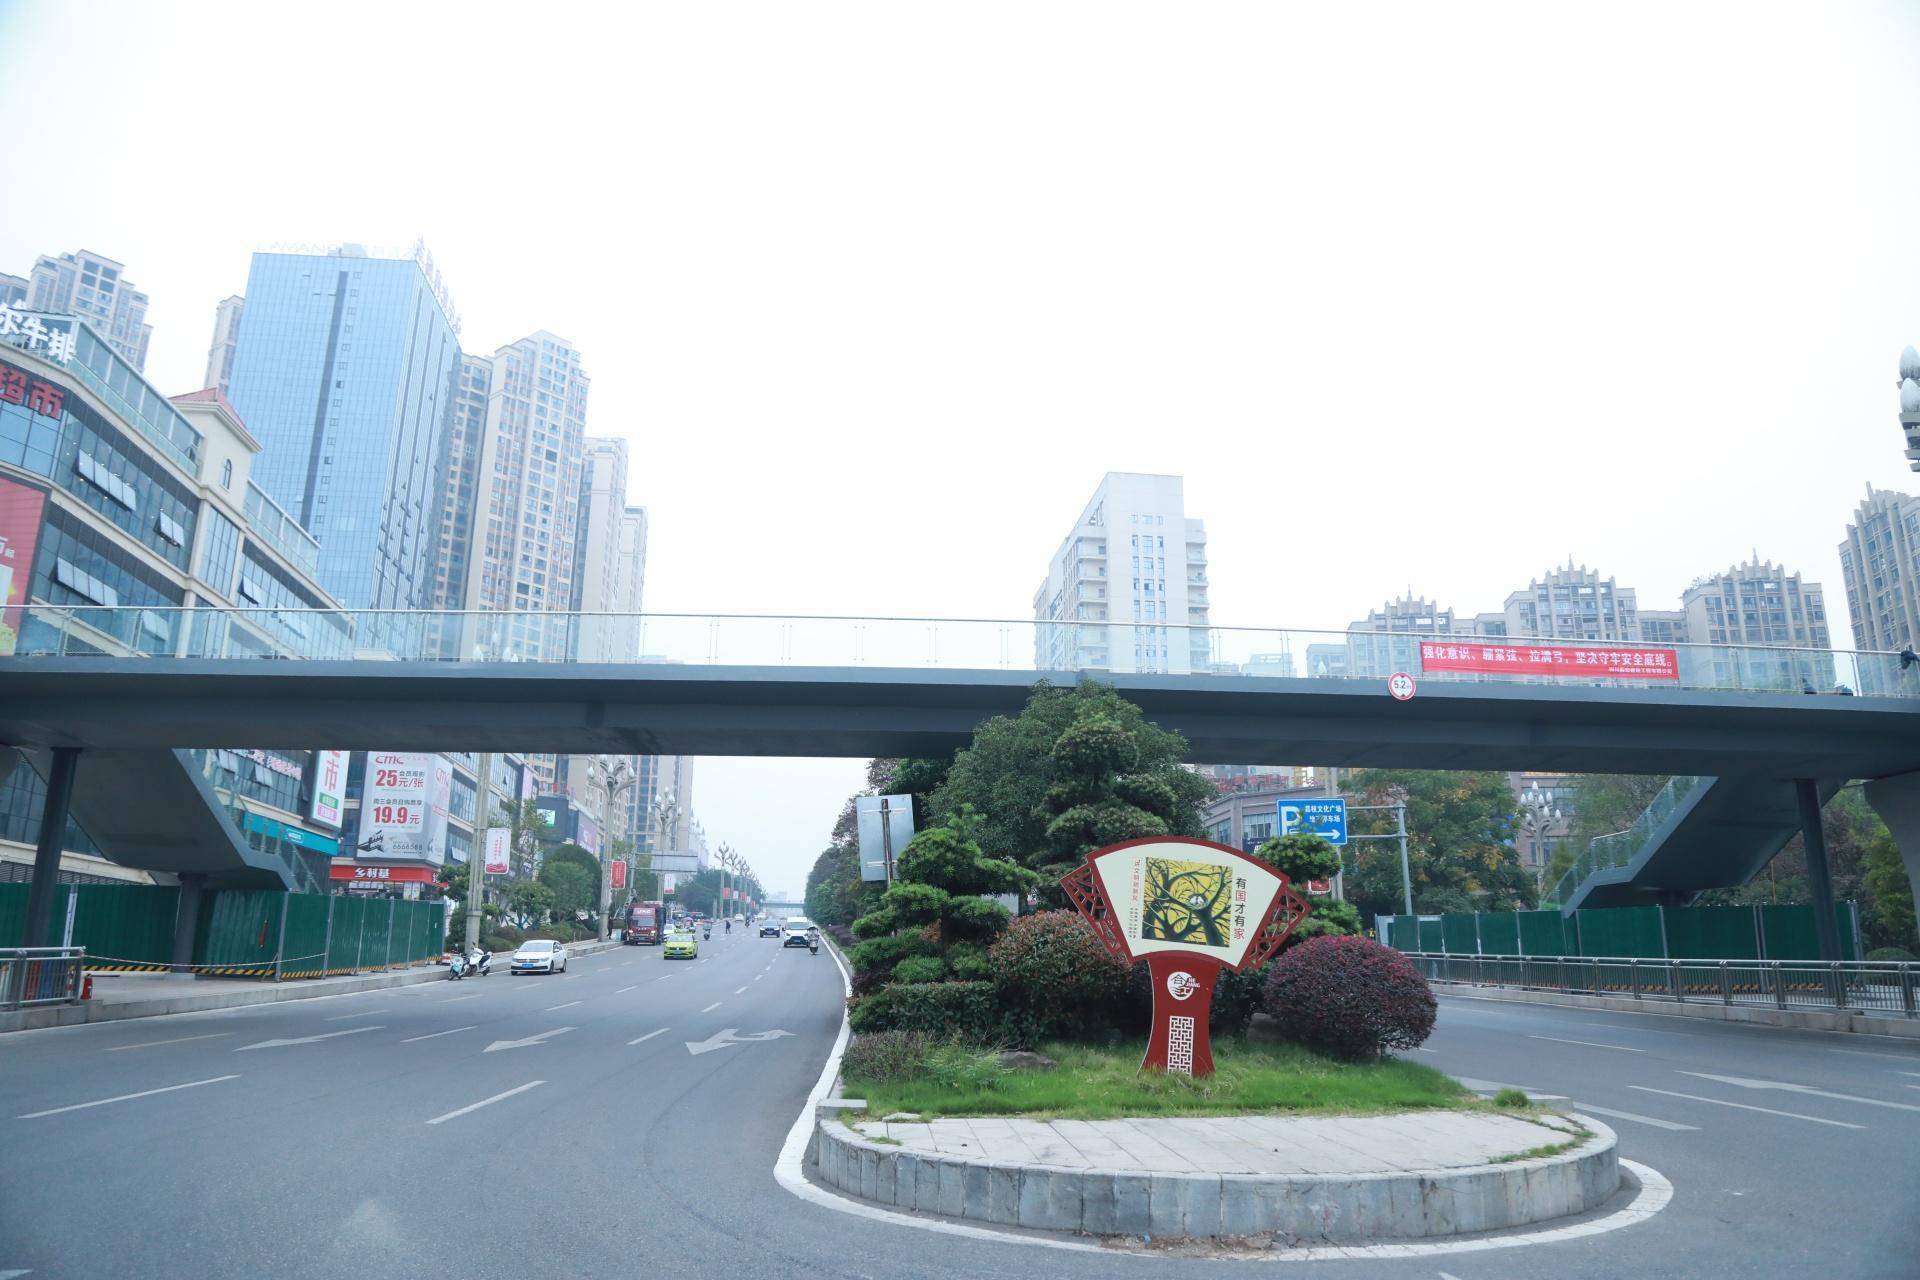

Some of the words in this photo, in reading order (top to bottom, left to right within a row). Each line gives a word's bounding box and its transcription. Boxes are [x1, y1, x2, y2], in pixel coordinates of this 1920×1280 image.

[375, 769, 398, 787] 25
[398, 777, 424, 788] 元/张
[373, 806, 408, 824] 19.9
[409, 814, 421, 825] 元
[354, 867, 391, 879] 乡村基
[1235, 877, 1247, 940] 有国才有家
